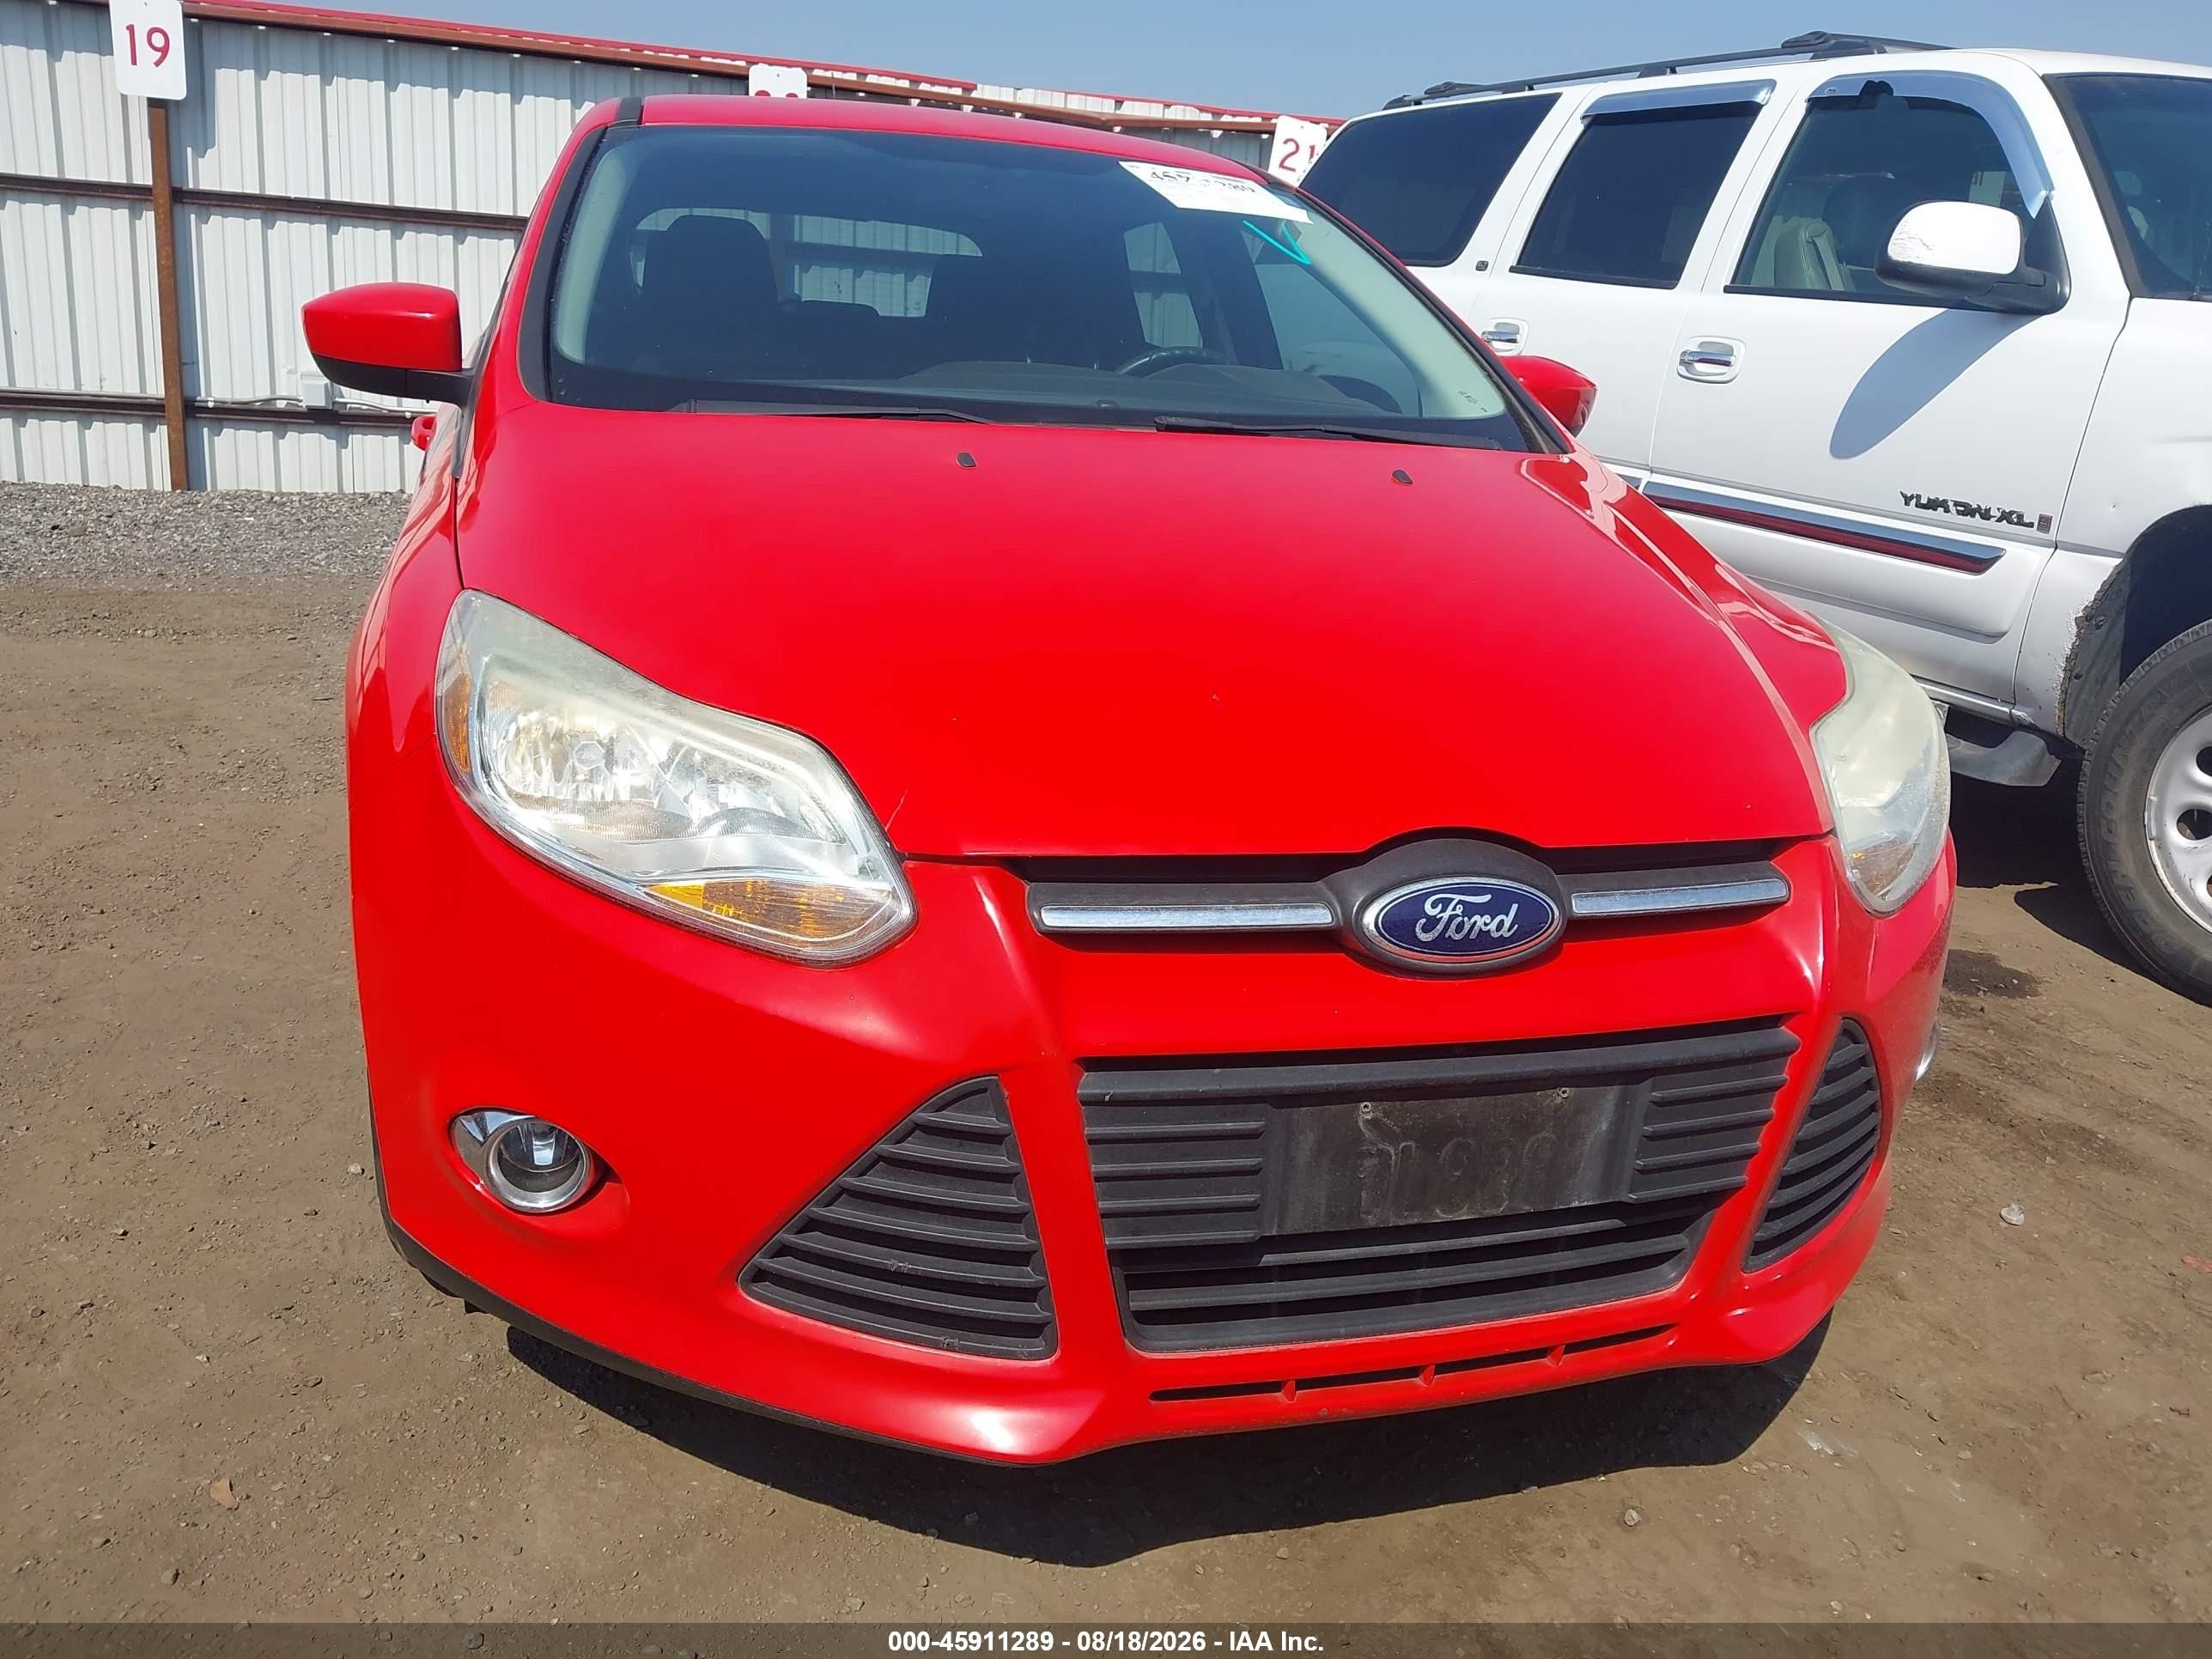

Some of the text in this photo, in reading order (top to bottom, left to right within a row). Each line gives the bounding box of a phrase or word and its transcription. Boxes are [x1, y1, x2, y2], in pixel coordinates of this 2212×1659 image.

[125, 23, 170, 68] 19
[1279, 137, 1316, 173] 21
[1995, 507, 2035, 529] XL
[1416, 892, 1519, 942] Ford
